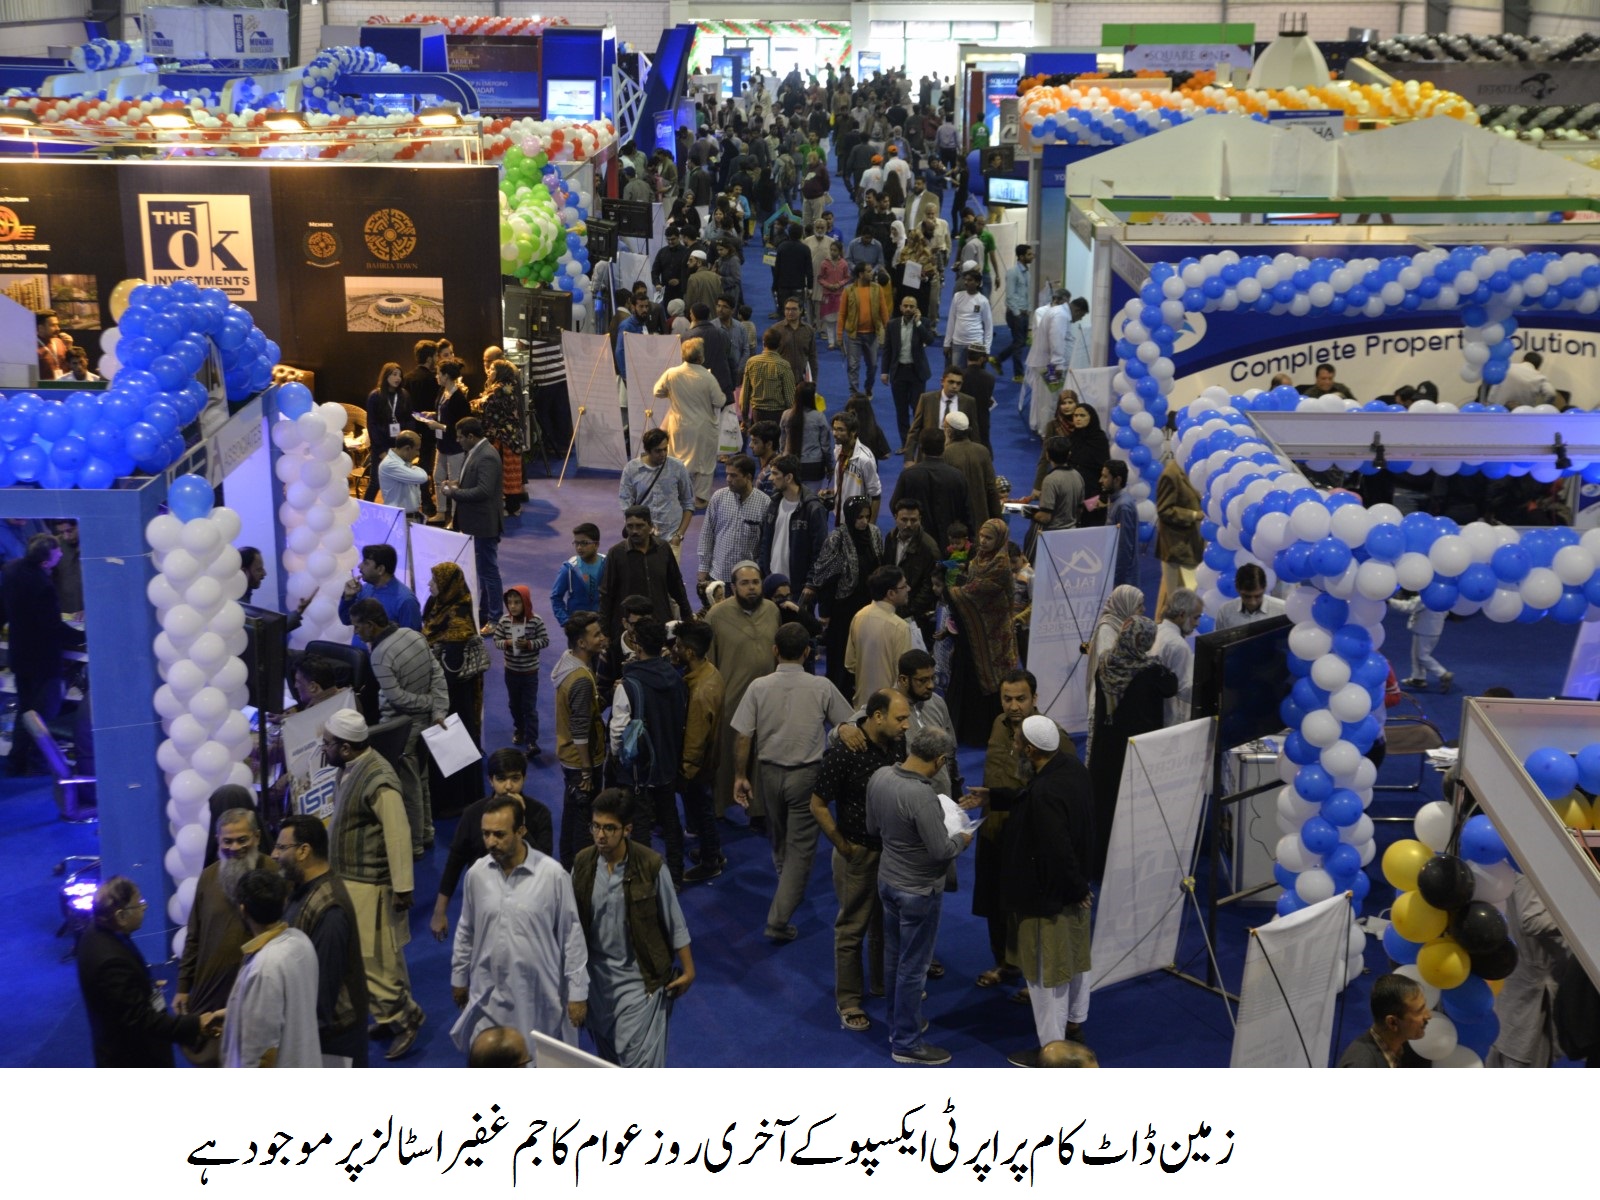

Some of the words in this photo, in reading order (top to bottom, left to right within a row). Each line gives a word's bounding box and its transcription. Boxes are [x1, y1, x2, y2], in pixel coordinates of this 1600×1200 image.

[152, 211, 191, 225] THE
[396, 262, 419, 270] TOWN
[1230, 340, 1356, 383] Complete
[1365, 329, 1465, 357] Propert
[1509, 329, 1597, 358] olution
